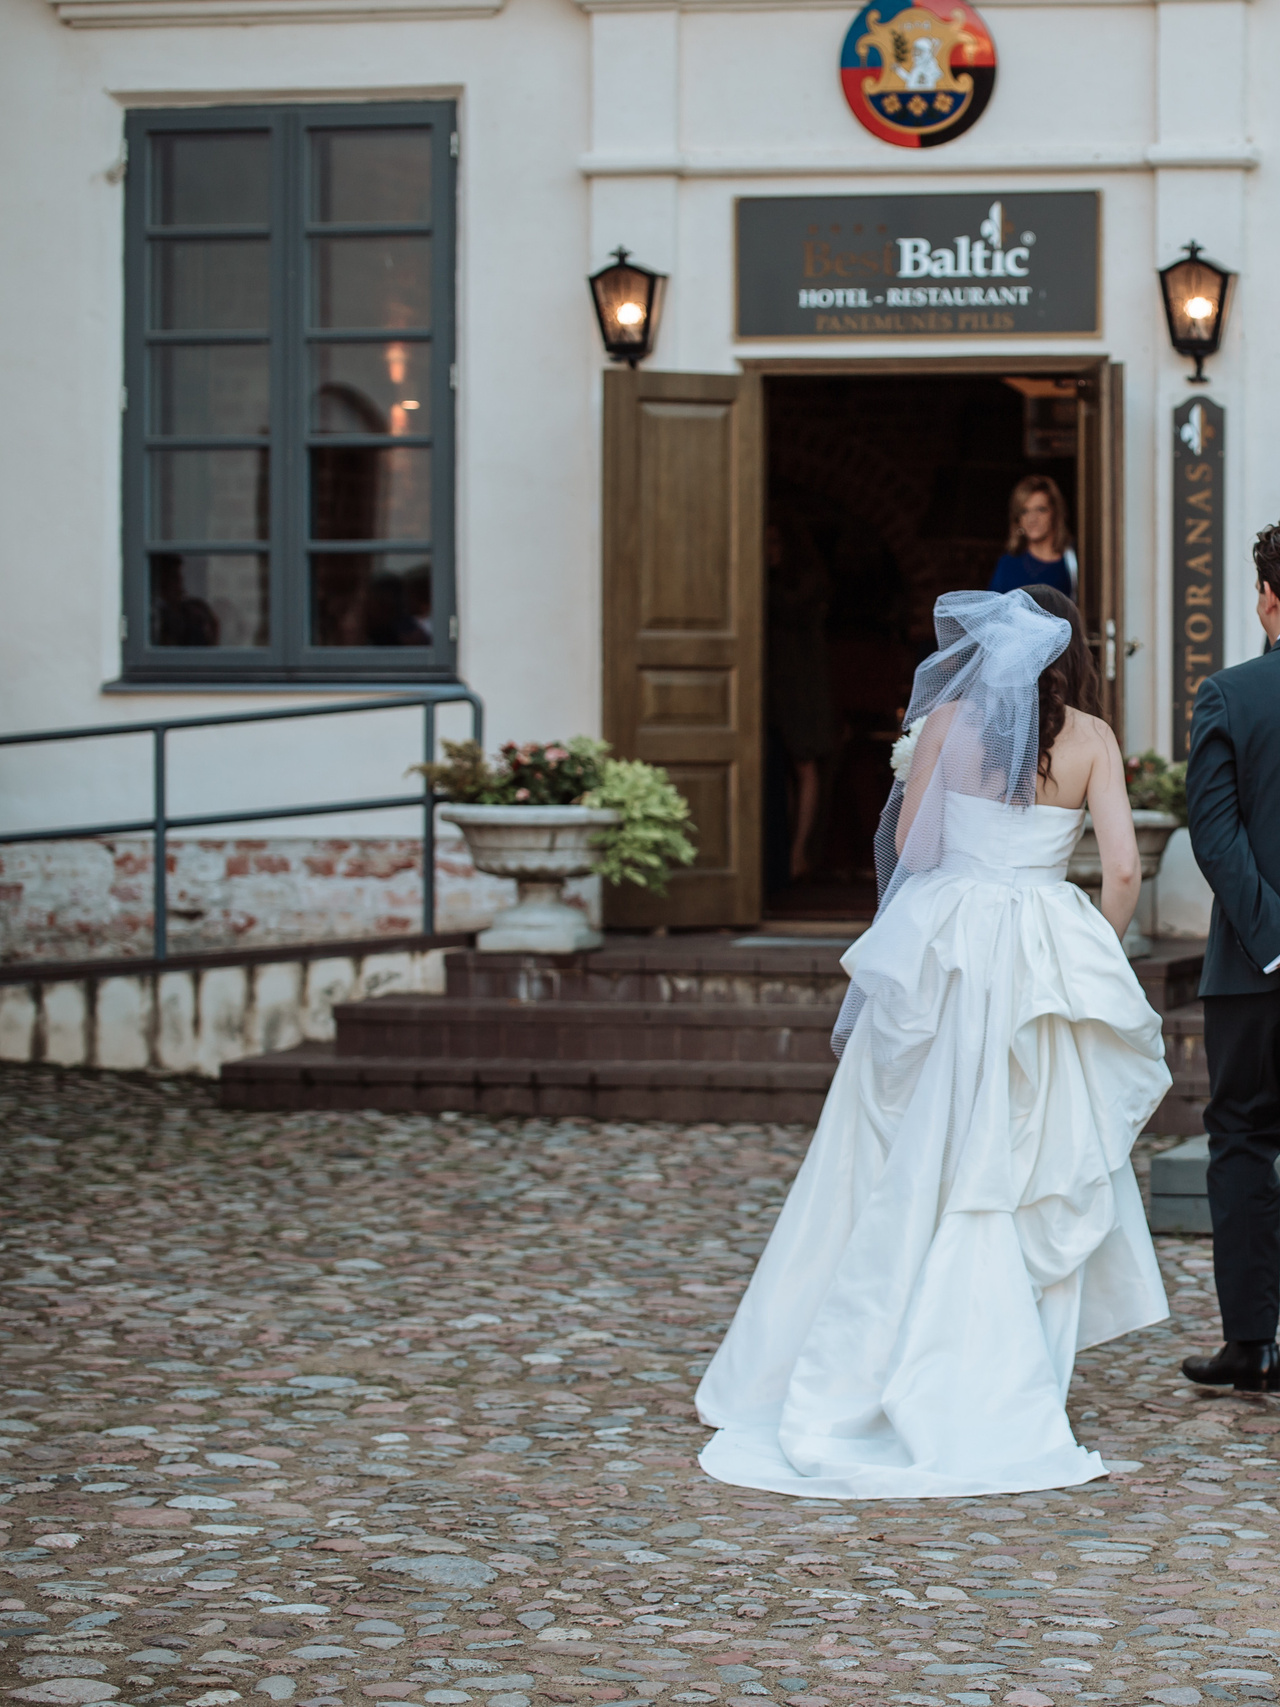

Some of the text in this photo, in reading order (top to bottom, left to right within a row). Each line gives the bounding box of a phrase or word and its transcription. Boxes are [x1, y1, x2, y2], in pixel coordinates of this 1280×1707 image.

[799, 287, 873, 308] HOTEL
[886, 285, 1033, 307] RESTAURANT
[957, 311, 1015, 331] PILIS
[1184, 462, 1213, 752] STORANAS
